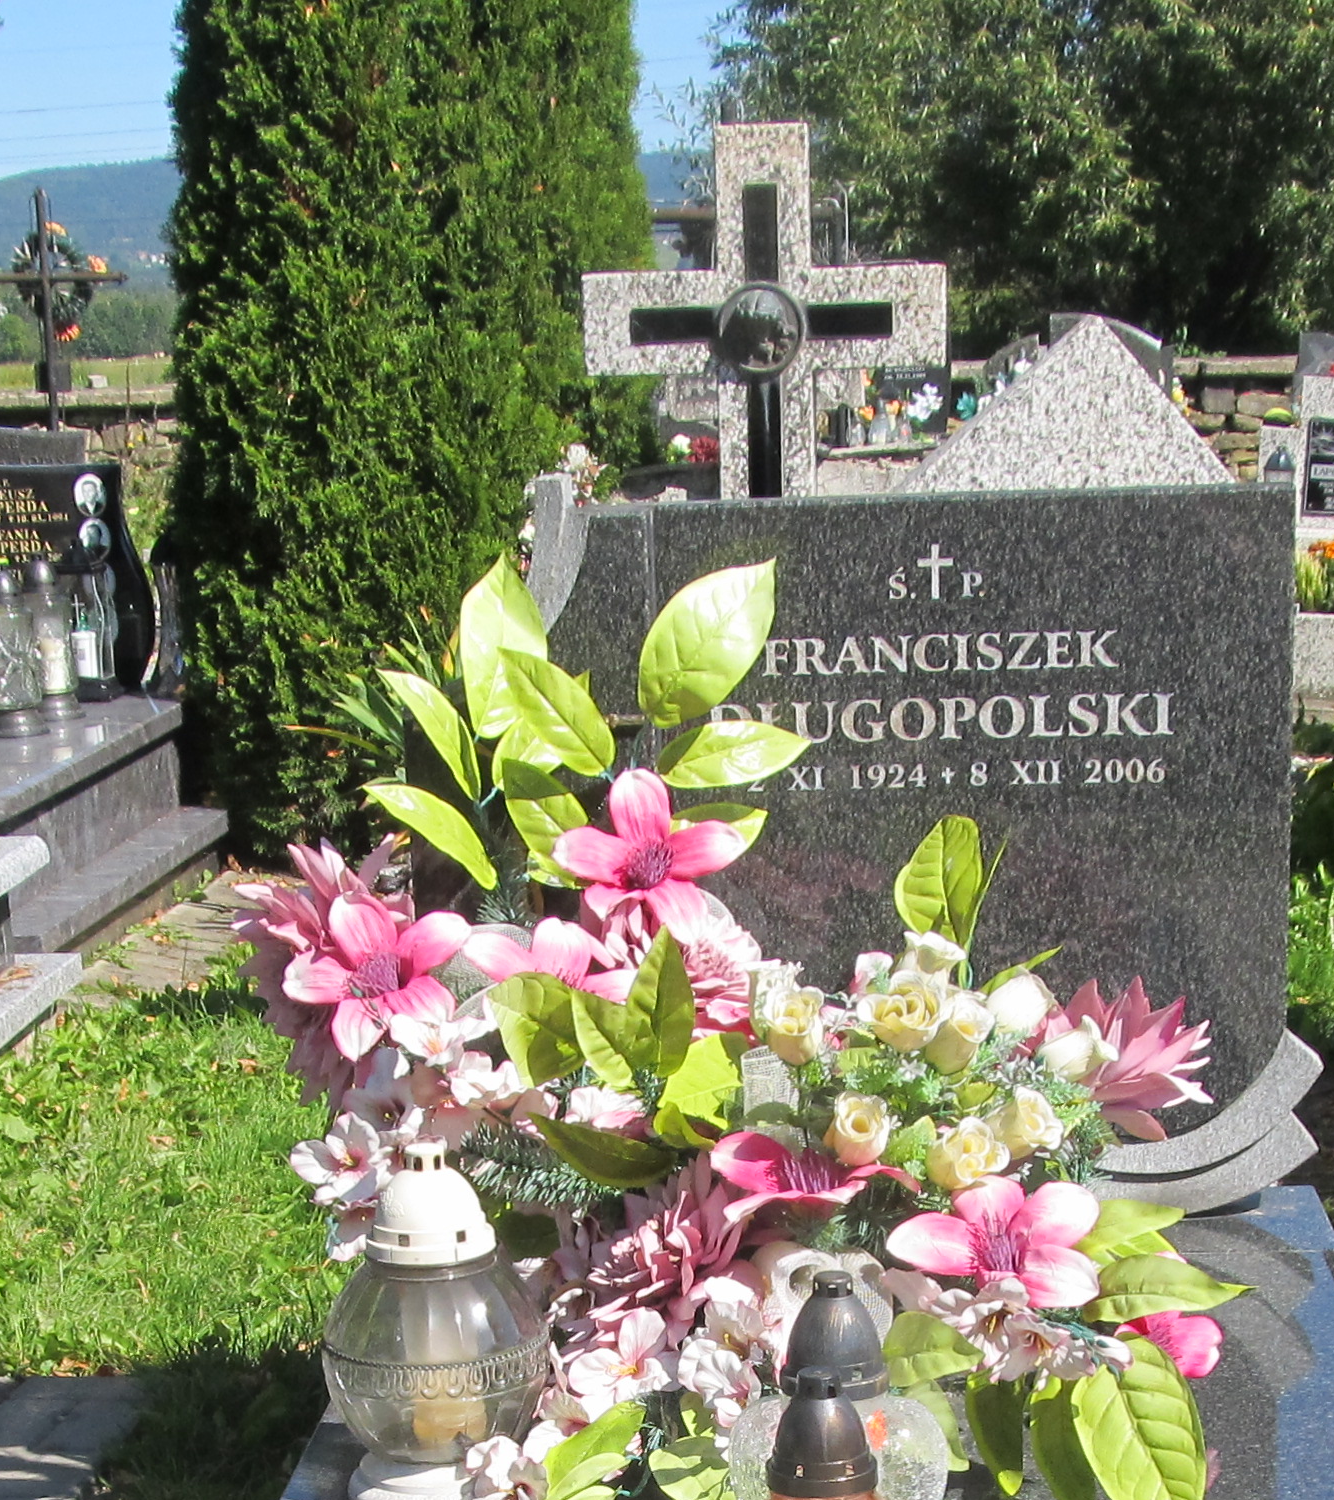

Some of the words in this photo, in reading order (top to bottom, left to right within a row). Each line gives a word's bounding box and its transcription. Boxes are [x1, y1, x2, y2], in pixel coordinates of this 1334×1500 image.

[887, 565, 916, 600] Ś.
[762, 629, 1120, 678] FRANCISZEK
[850, 763, 927, 790] 1924
[969, 761, 989, 785] 8
[1010, 759, 1062, 786] XII
[1083, 757, 1166, 784] 2006
